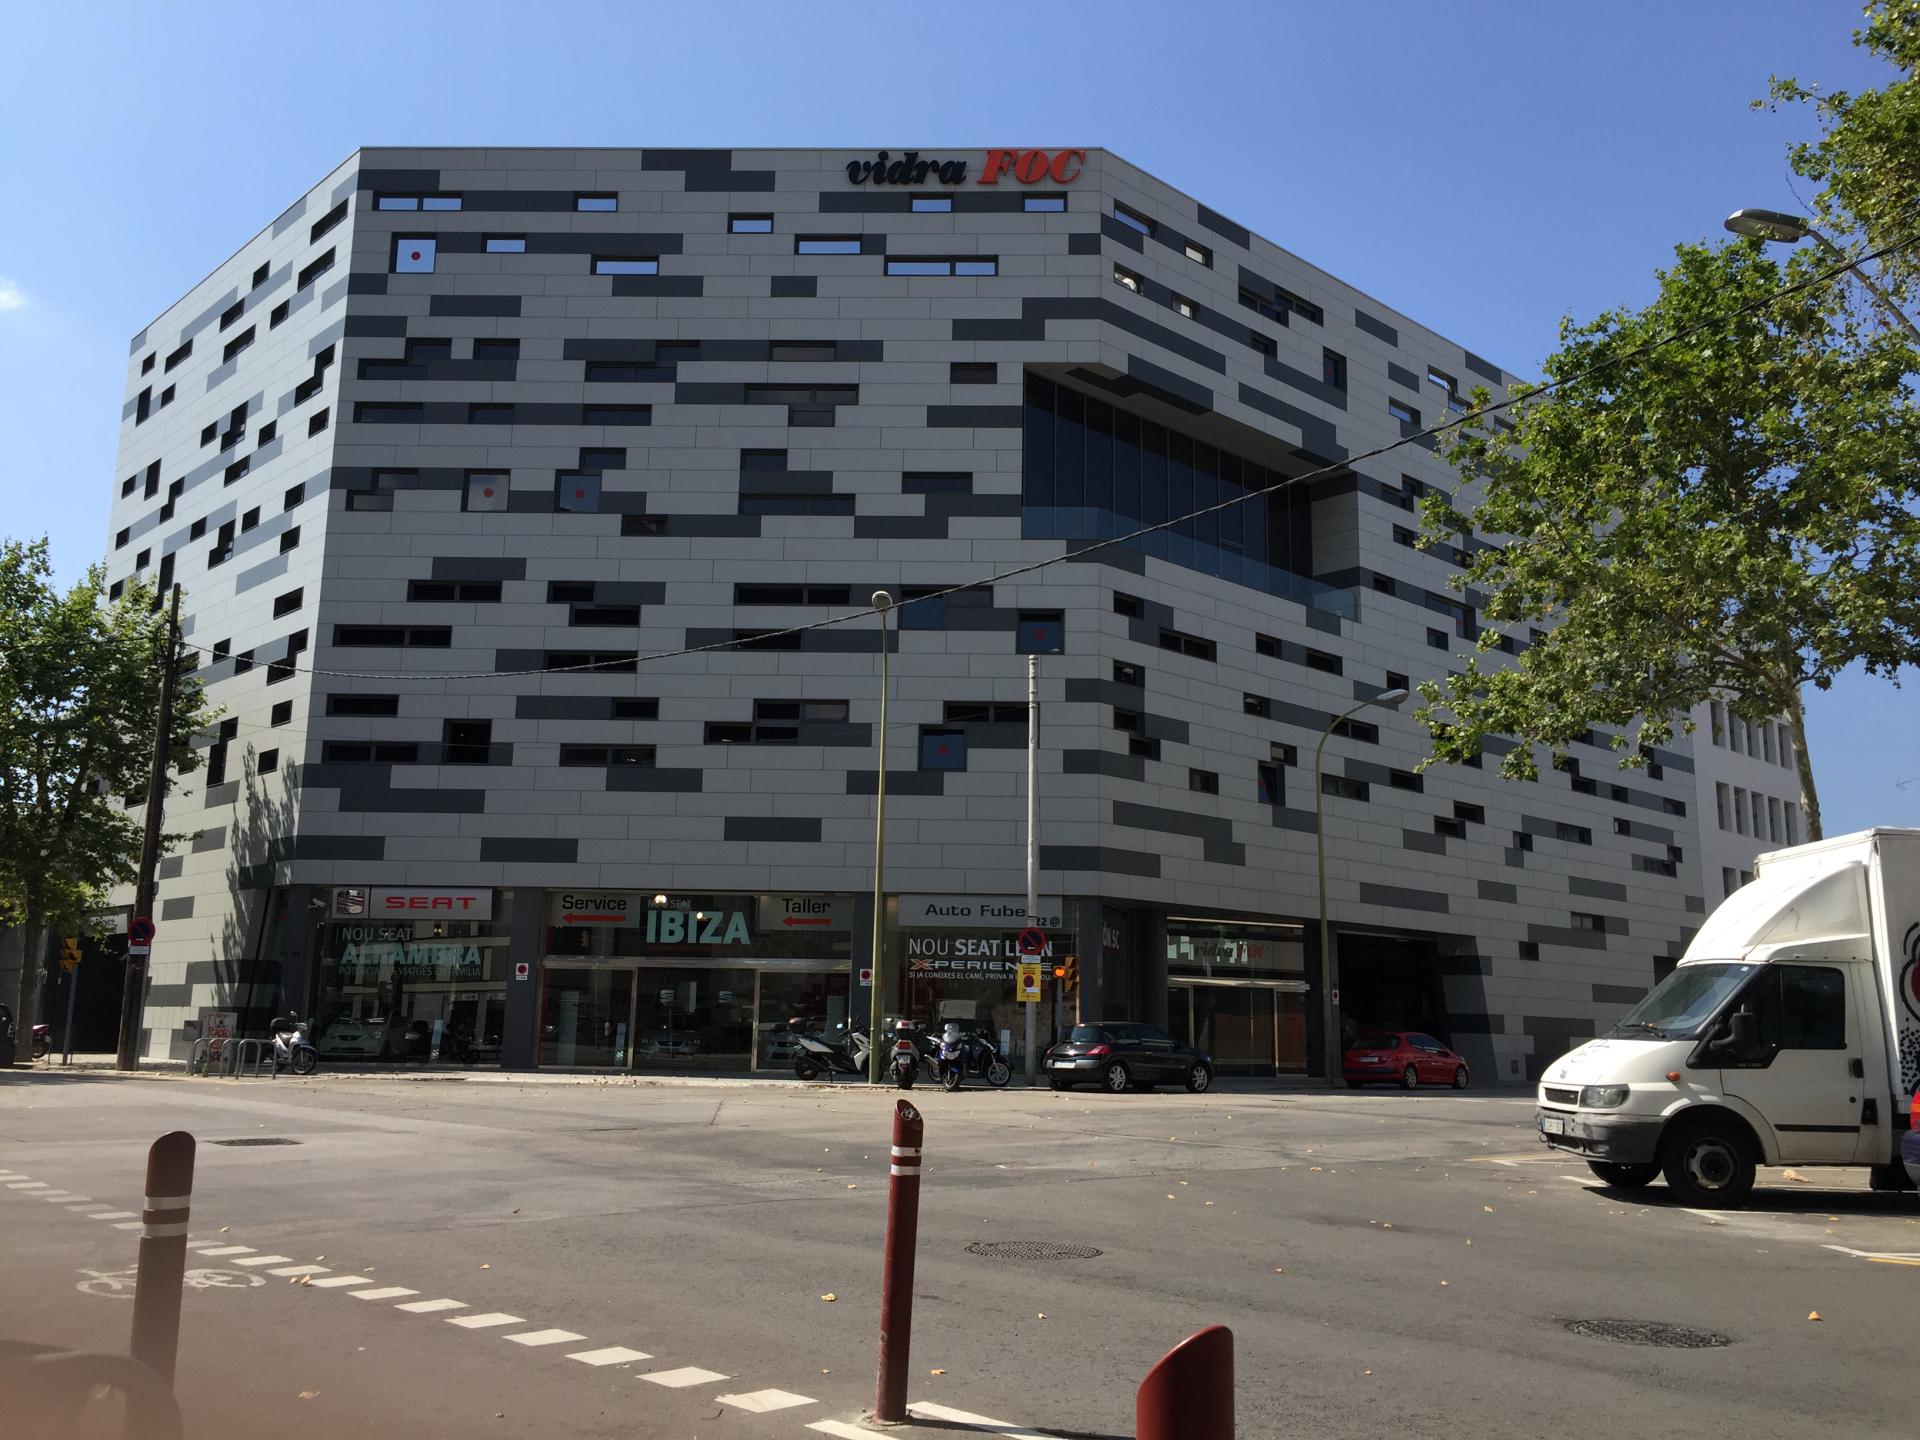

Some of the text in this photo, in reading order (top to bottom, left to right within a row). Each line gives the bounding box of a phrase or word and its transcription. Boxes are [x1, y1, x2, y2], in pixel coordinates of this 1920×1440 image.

[846, 149, 1087, 185] vidra FOC
[384, 896, 477, 910] SEAT
[562, 894, 627, 910] Service
[782, 898, 831, 913] Taller
[925, 904, 971, 917] Auto
[342, 927, 413, 941] NOU SEAT
[645, 910, 751, 945] IBIZA
[908, 937, 1053, 957] NOU SEAT LEN
[910, 958, 1053, 972] XPERIENE
